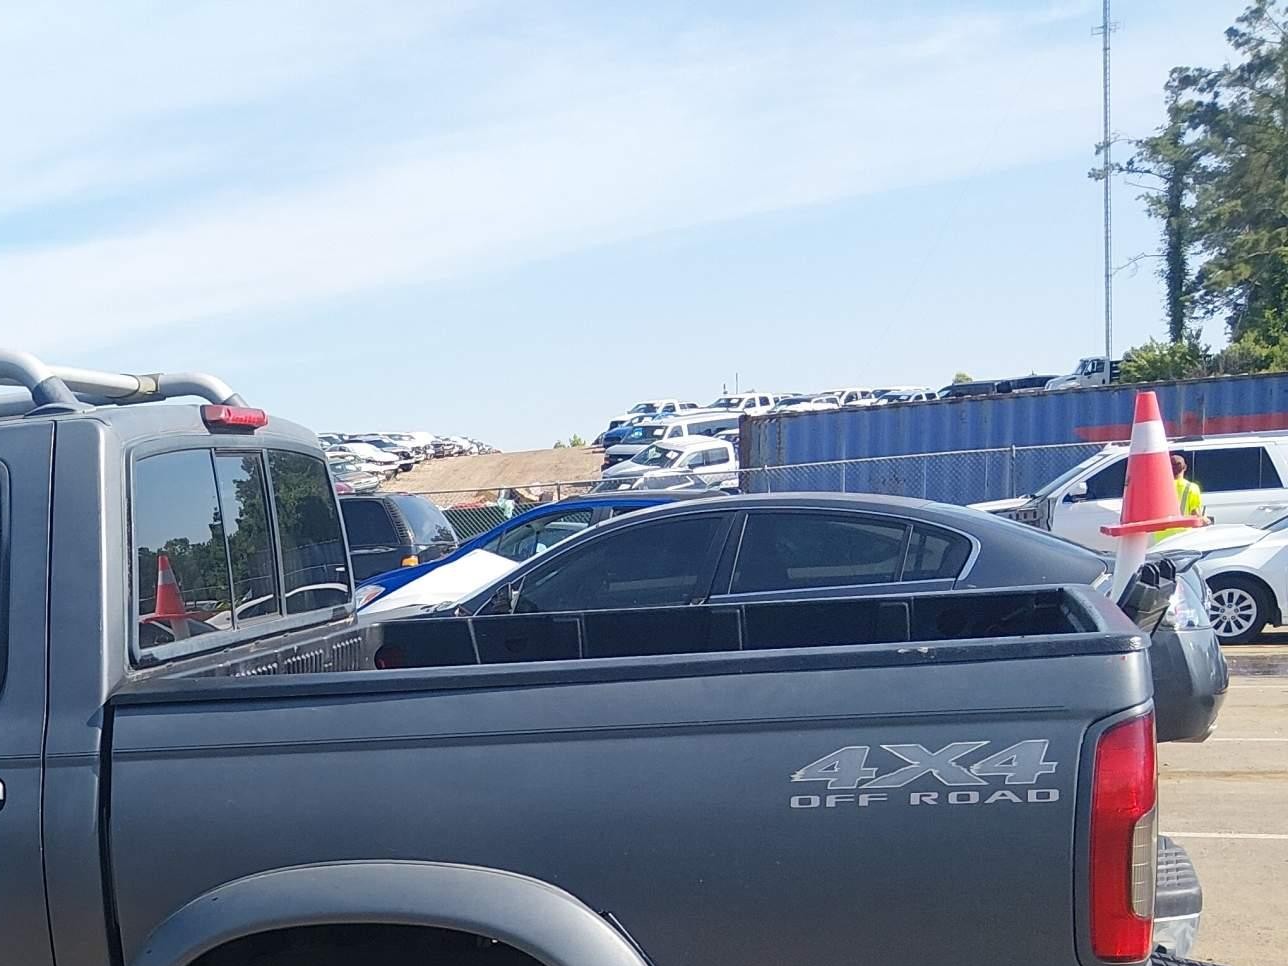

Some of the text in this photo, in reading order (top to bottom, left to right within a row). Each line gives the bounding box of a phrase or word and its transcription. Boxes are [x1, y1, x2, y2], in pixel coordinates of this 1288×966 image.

[791, 739, 1058, 789] 4X4
[790, 788, 1060, 809] OFF ROAD
